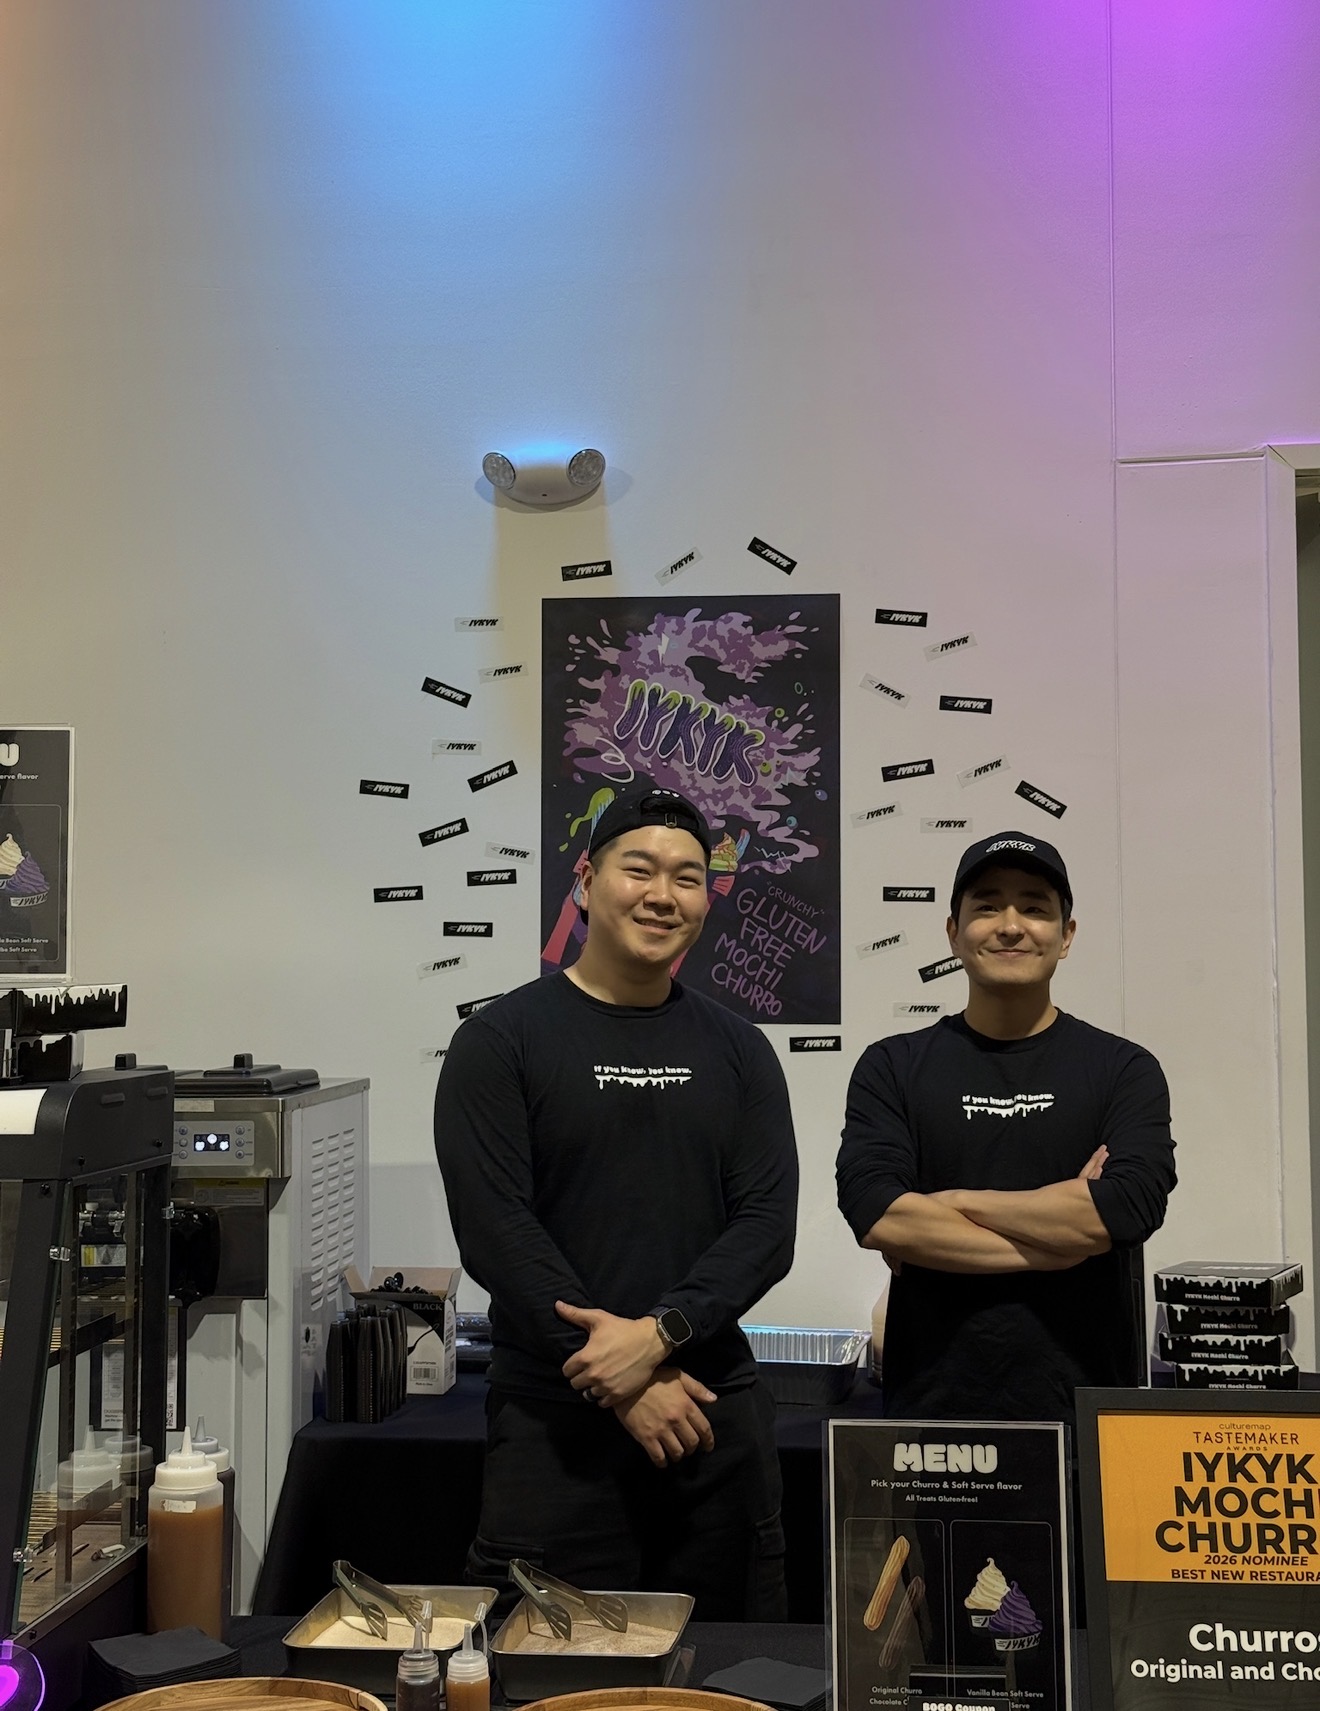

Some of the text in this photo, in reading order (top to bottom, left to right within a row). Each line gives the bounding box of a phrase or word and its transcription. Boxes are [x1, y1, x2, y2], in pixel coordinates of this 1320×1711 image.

[670, 551, 695, 575] IYKYK
[761, 548, 792, 568] IYKYK
[575, 563, 607, 576] IYKYK
[468, 618, 499, 627] IYKYK
[889, 613, 923, 623] IYKYK
[940, 635, 970, 652] IYKYK
[493, 664, 523, 677] IYKYK
[435, 686, 466, 702] IYKYK
[874, 682, 905, 701] IYKYK
[953, 699, 987, 710] IYKYK
[613, 678, 766, 786] IYKYK
[446, 742, 477, 751] IYKYK
[481, 763, 513, 786] IYKYK
[896, 762, 928, 776] IYKYK
[973, 758, 1002, 778] IYKYK
[17, 772, 39, 780] flavor
[373, 784, 405, 794] IYKYK
[1029, 791, 1061, 812] IYKYK
[866, 804, 896, 820] IYKYK
[432, 821, 463, 840] IYKYK
[935, 819, 968, 829] IYKYK
[499, 847, 530, 859] IYKYK
[480, 871, 512, 882] IYKYK
[387, 888, 419, 899] IYKYK
[896, 889, 930, 898] IYKYK
[736, 887, 827, 954] GLUTEN
[456, 924, 488, 933] IYKYK
[740, 917, 796, 968] FREE
[871, 934, 901, 951] IYKYK
[432, 956, 461, 971] IYKYK
[714, 932, 783, 990] MOCHI
[711, 962, 782, 1016] CHURRO
[908, 1005, 941, 1013] IYKYK
[803, 1038, 836, 1048] IYKYK
[593, 1065, 602, 1073] If
[603, 1065, 620, 1074] you
[665, 1066, 692, 1074] know.
[972, 1096, 989, 1104] you
[1028, 1093, 1055, 1102] know.
[412, 1302, 443, 1311] BLACK
[1218, 1422, 1271, 1431] culturemap
[1192, 1431, 1300, 1446] TASTEMAKER
[892, 1442, 998, 1474] MENU
[1182, 1451, 1318, 1485] IYKYK
[870, 1479, 1023, 1491] Pick your Churro & Soft Serve flavor
[905, 1494, 915, 1503] All
[915, 1495, 937, 1503] Treats
[1174, 1486, 1320, 1520] MOCH
[1203, 1554, 1309, 1567] 2026 NOMINEE
[1170, 1568, 1207, 1580] BEST
[1211, 1569, 1245, 1581] NEW
[1188, 1623, 1320, 1653] Churro
[1130, 1658, 1224, 1683] Original
[1230, 1661, 1275, 1681] and
[871, 1686, 923, 1696] Original Churro
[966, 1689, 1044, 1698] Vanilla Bean Soft Serve
[869, 1698, 903, 1706] Chocolate
[922, 1702, 953, 1711] BOGO
[1011, 1702, 1030, 1710] Serve
